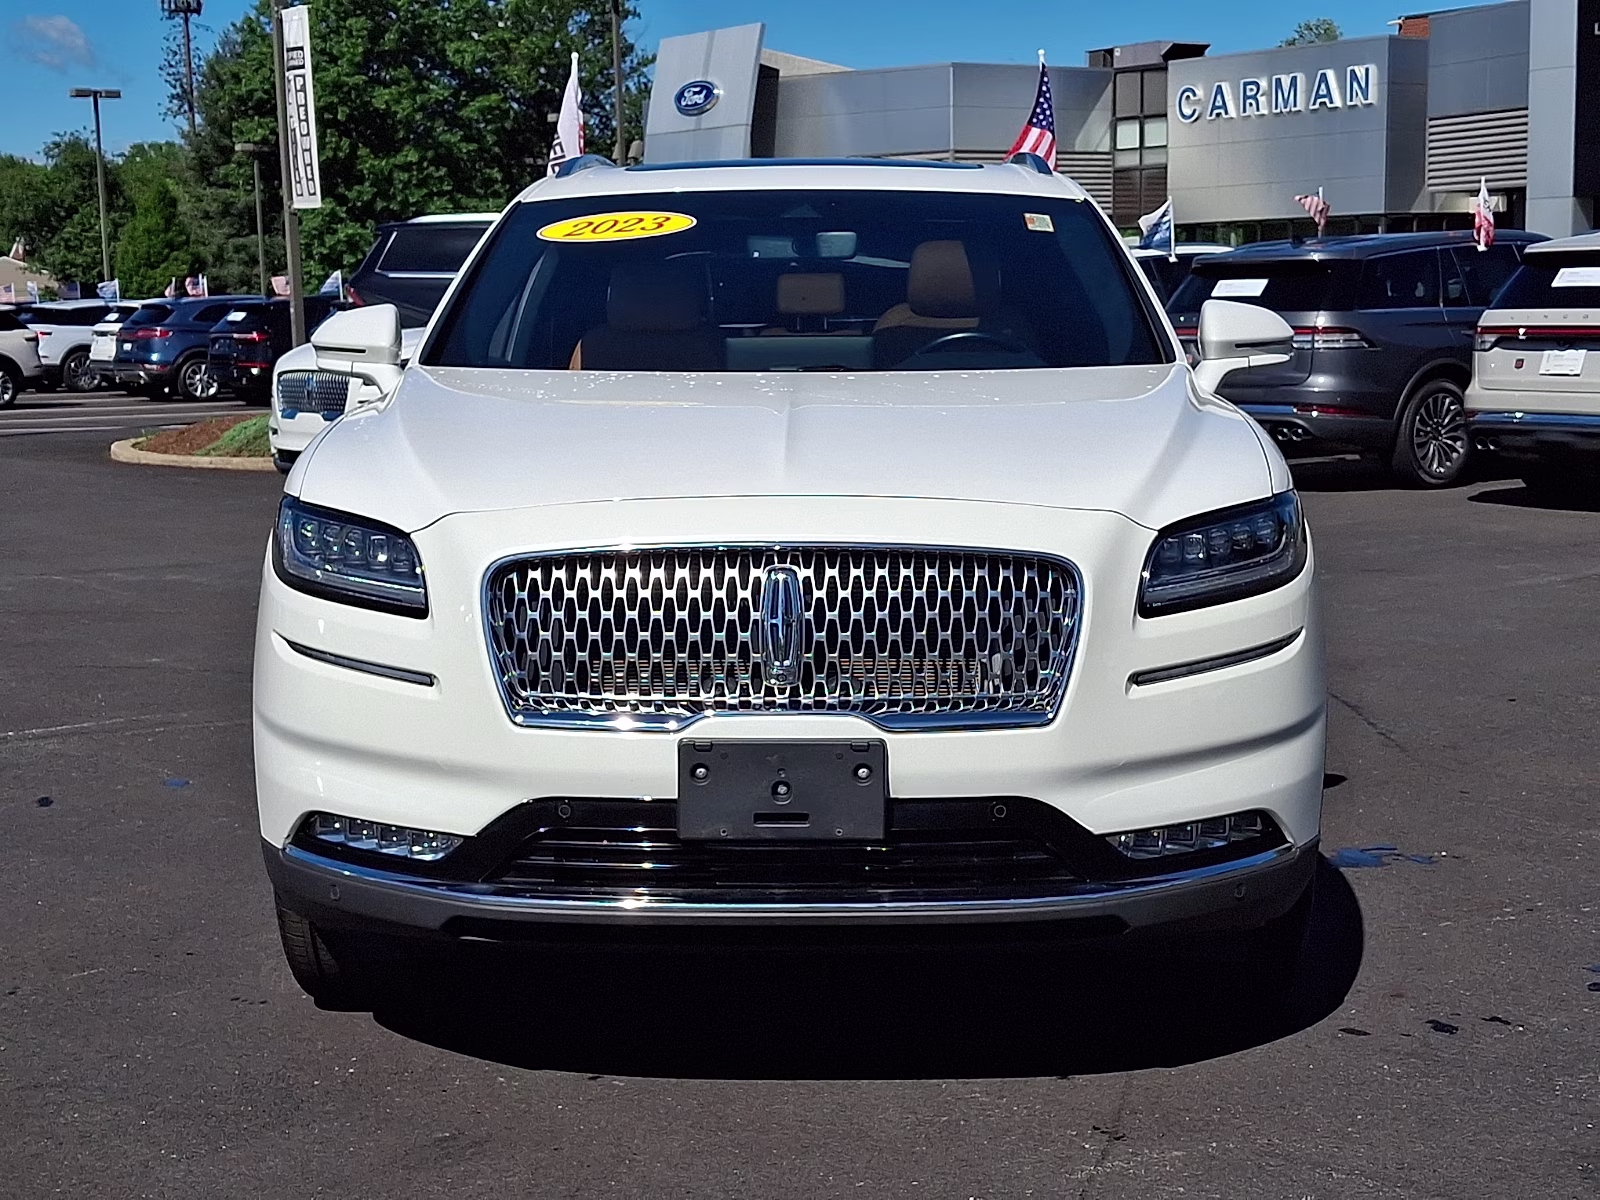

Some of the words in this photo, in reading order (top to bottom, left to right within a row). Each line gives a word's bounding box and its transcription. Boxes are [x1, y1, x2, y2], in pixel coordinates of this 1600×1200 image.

[681, 87, 706, 106] Ford
[1176, 64, 1377, 123] CARMAN
[562, 216, 672, 238] 2023
